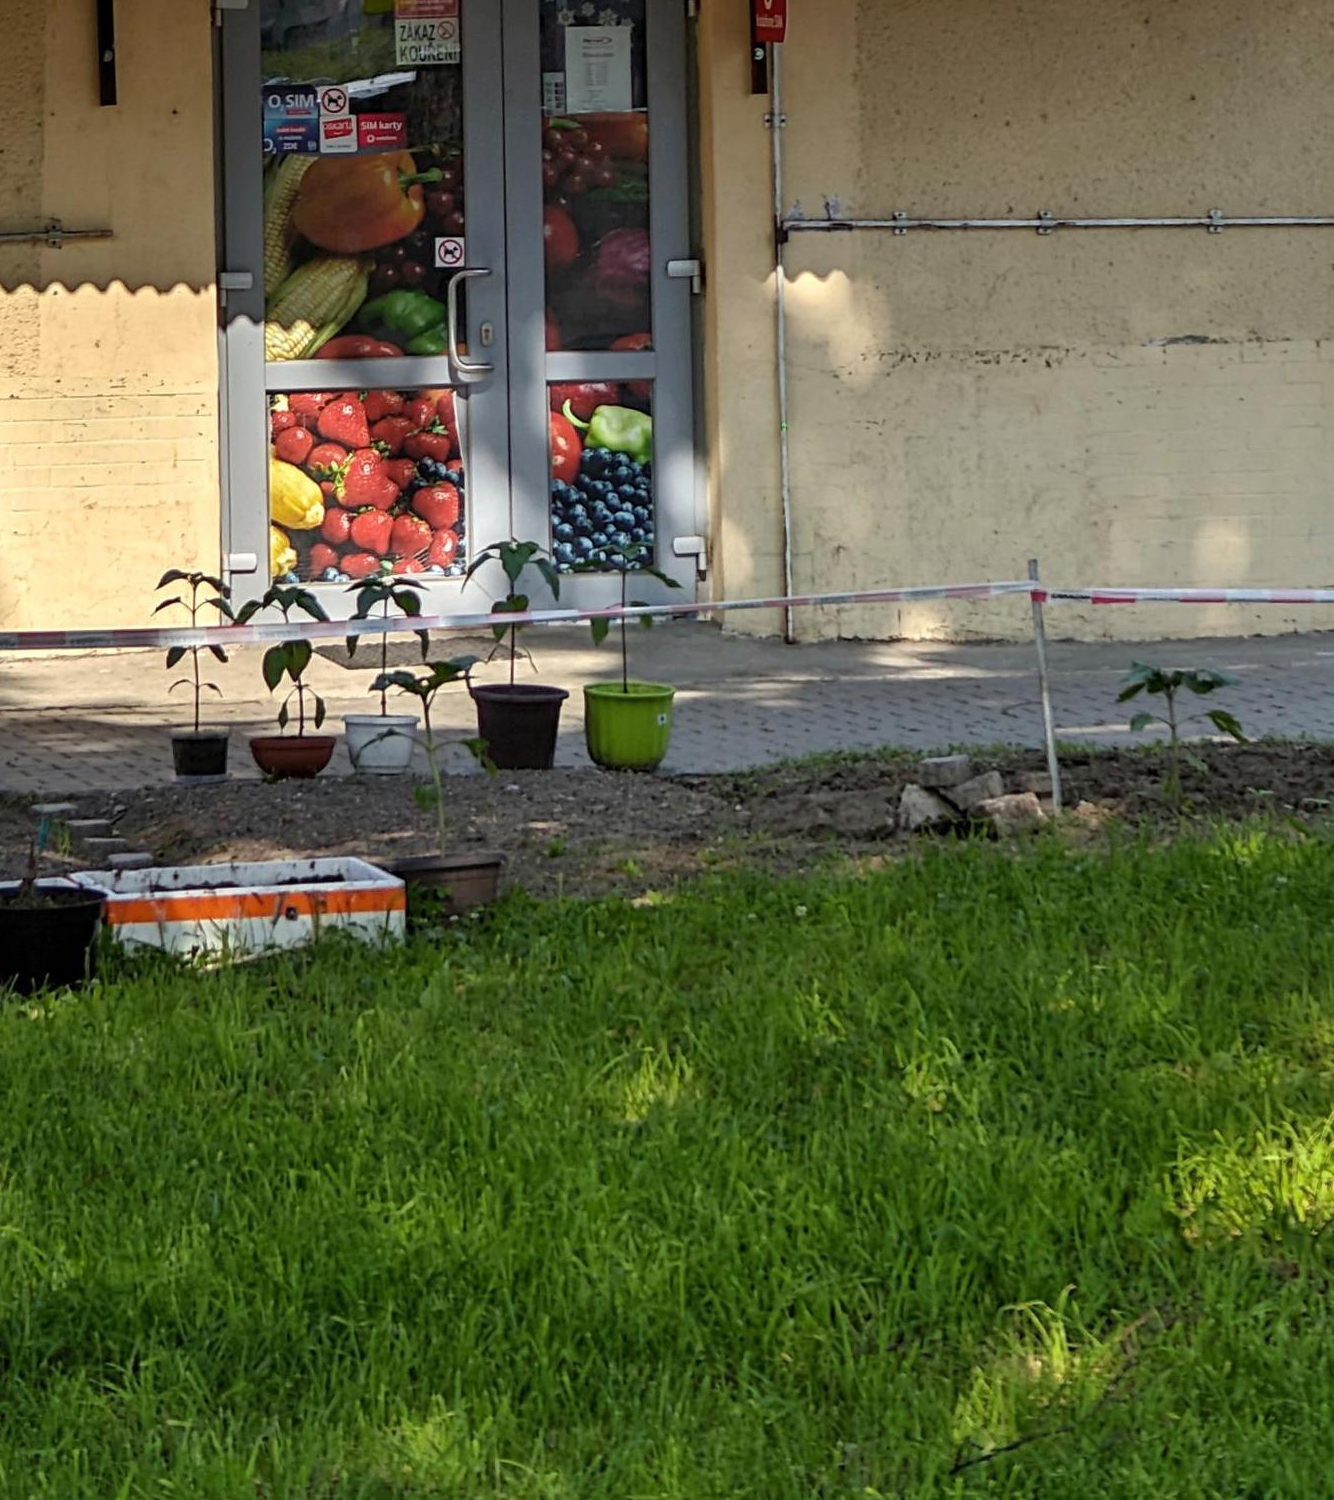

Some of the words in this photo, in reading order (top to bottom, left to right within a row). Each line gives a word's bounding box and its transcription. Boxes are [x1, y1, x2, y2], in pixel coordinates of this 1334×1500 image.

[286, 94, 314, 108] SIM
[361, 121, 378, 131] SIM
[379, 120, 403, 132] karty
